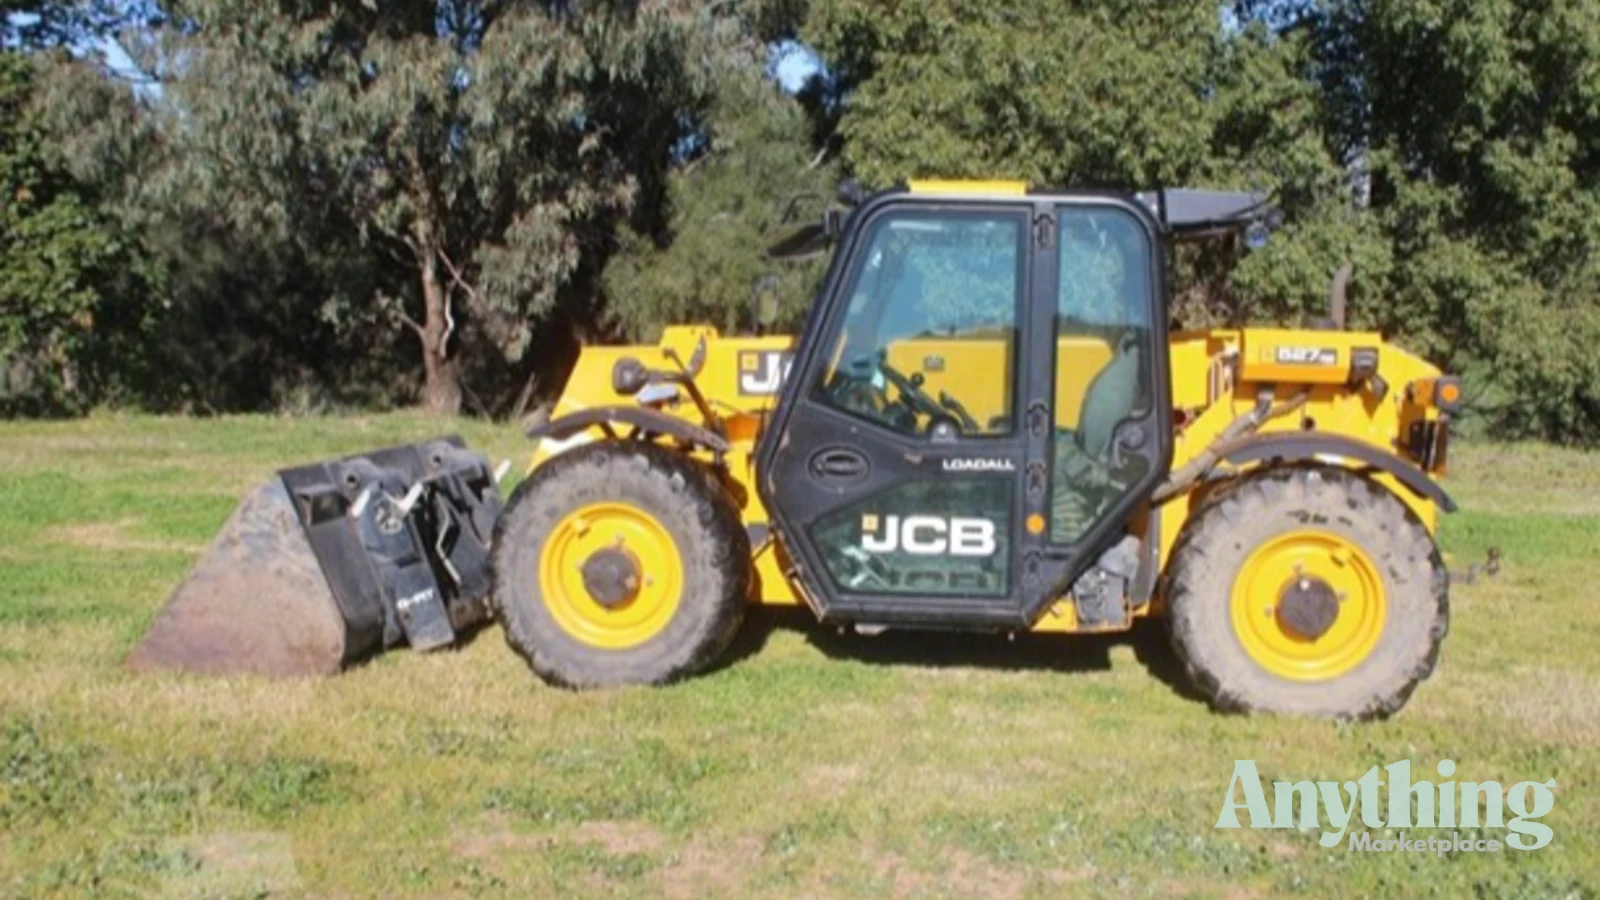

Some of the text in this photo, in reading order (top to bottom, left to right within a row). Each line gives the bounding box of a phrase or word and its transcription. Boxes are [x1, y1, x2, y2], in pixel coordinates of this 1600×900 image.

[741, 353, 794, 393] J
[942, 458, 1015, 471] LOADALL
[862, 514, 996, 556] JCB
